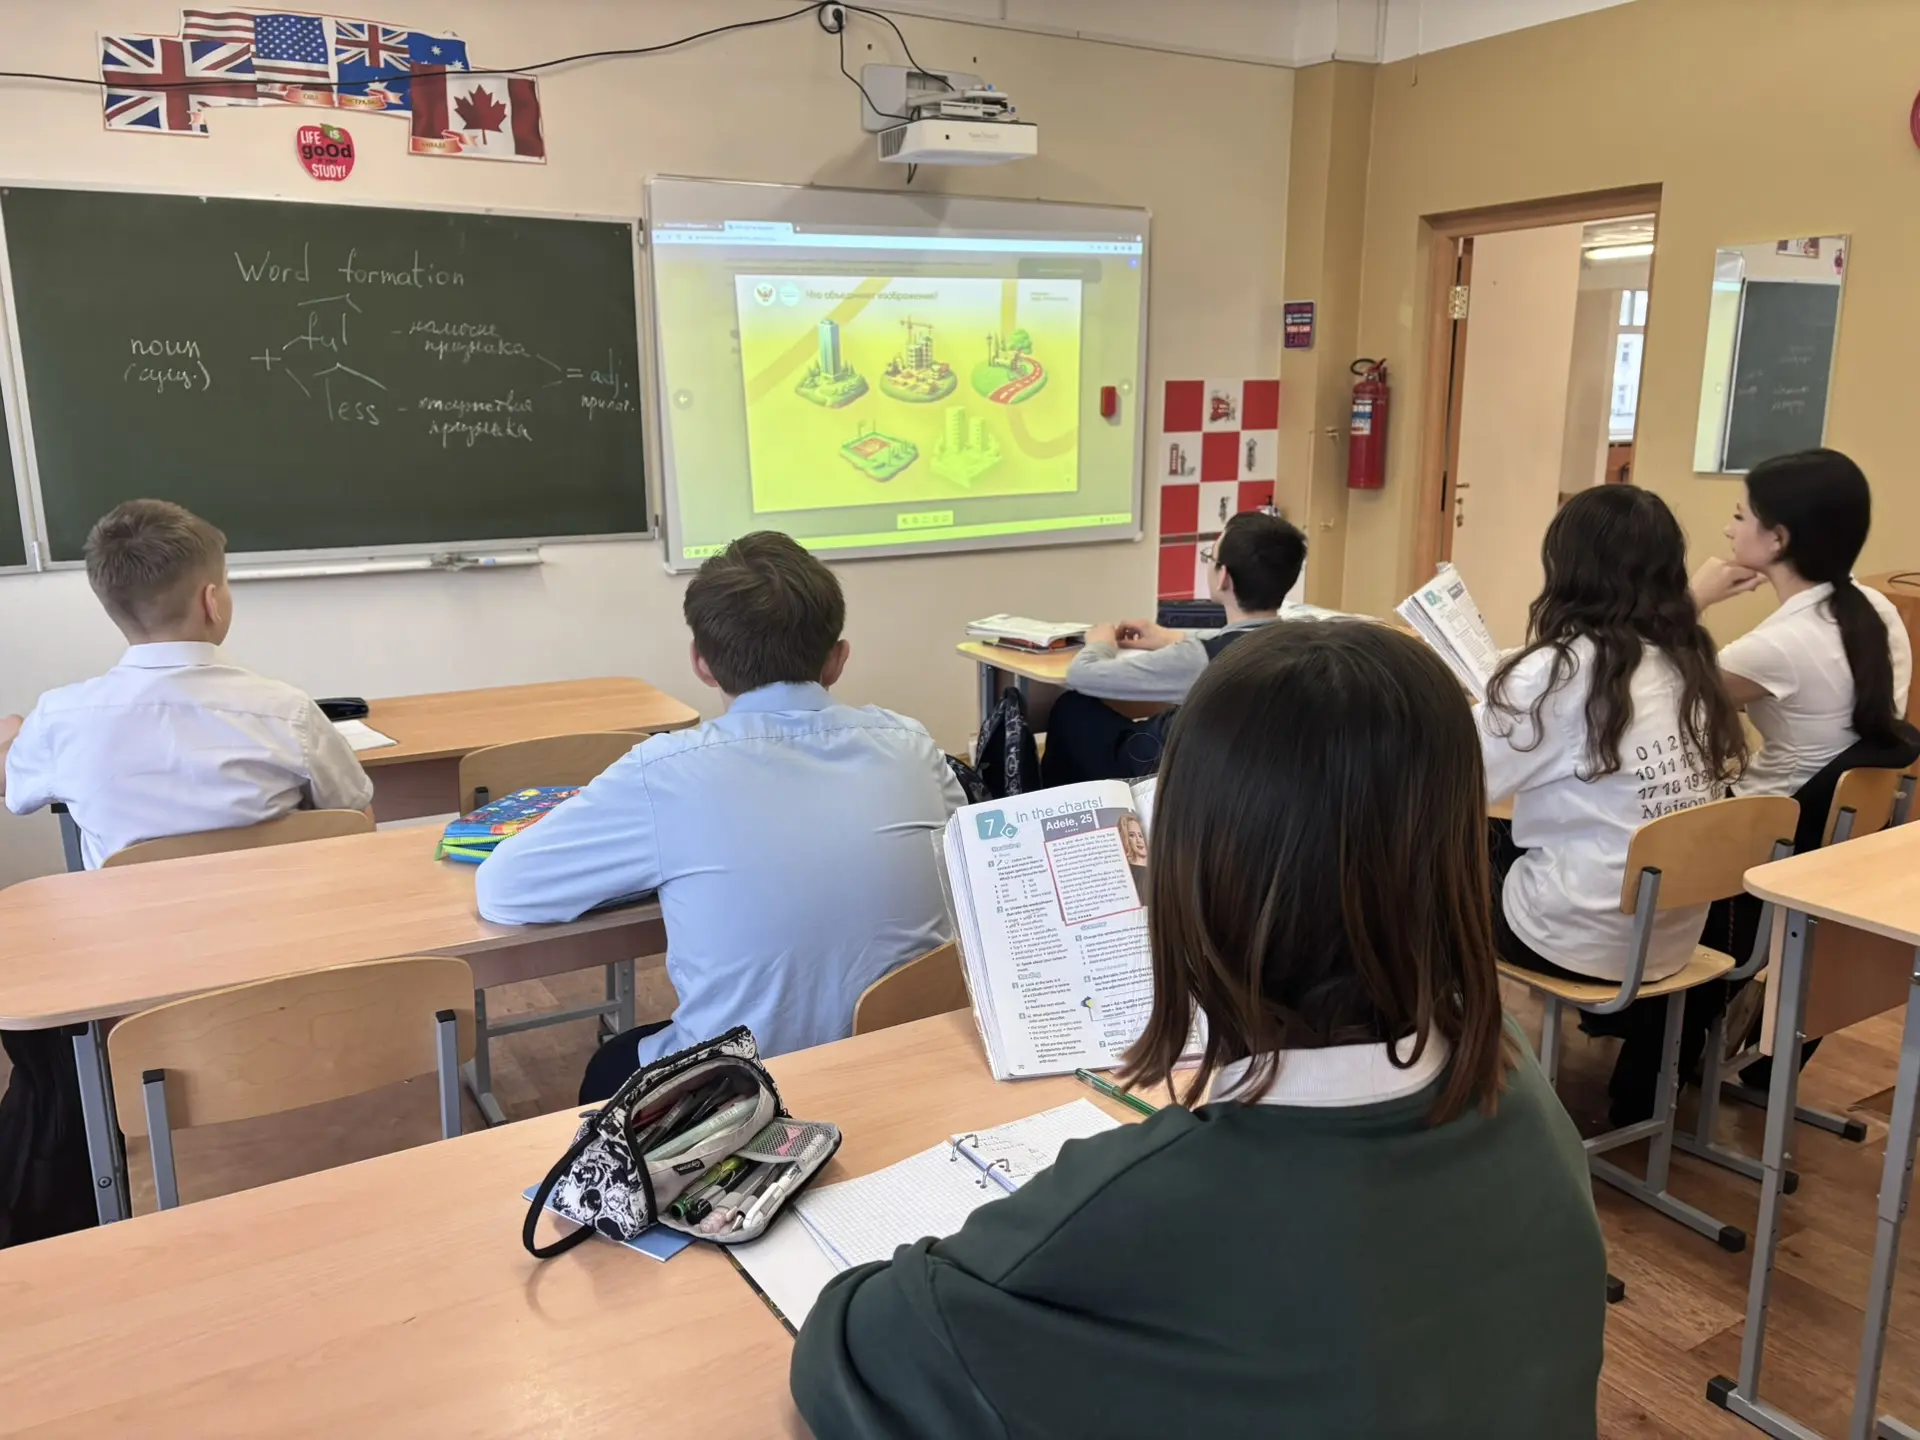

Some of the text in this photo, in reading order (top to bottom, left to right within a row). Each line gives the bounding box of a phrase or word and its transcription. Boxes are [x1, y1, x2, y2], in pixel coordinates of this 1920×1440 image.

[300, 129, 340, 145] LIFE IS
[311, 163, 347, 178] STUDY!
[234, 242, 464, 288] Word formation
[301, 311, 348, 352] ful
[131, 338, 201, 358] noun
[325, 378, 380, 425] less
[1638, 786, 1658, 800] 17
[1015, 796, 1103, 824] In the charts!
[984, 818, 996, 836] 7
[1046, 813, 1093, 831] Adele, 25
